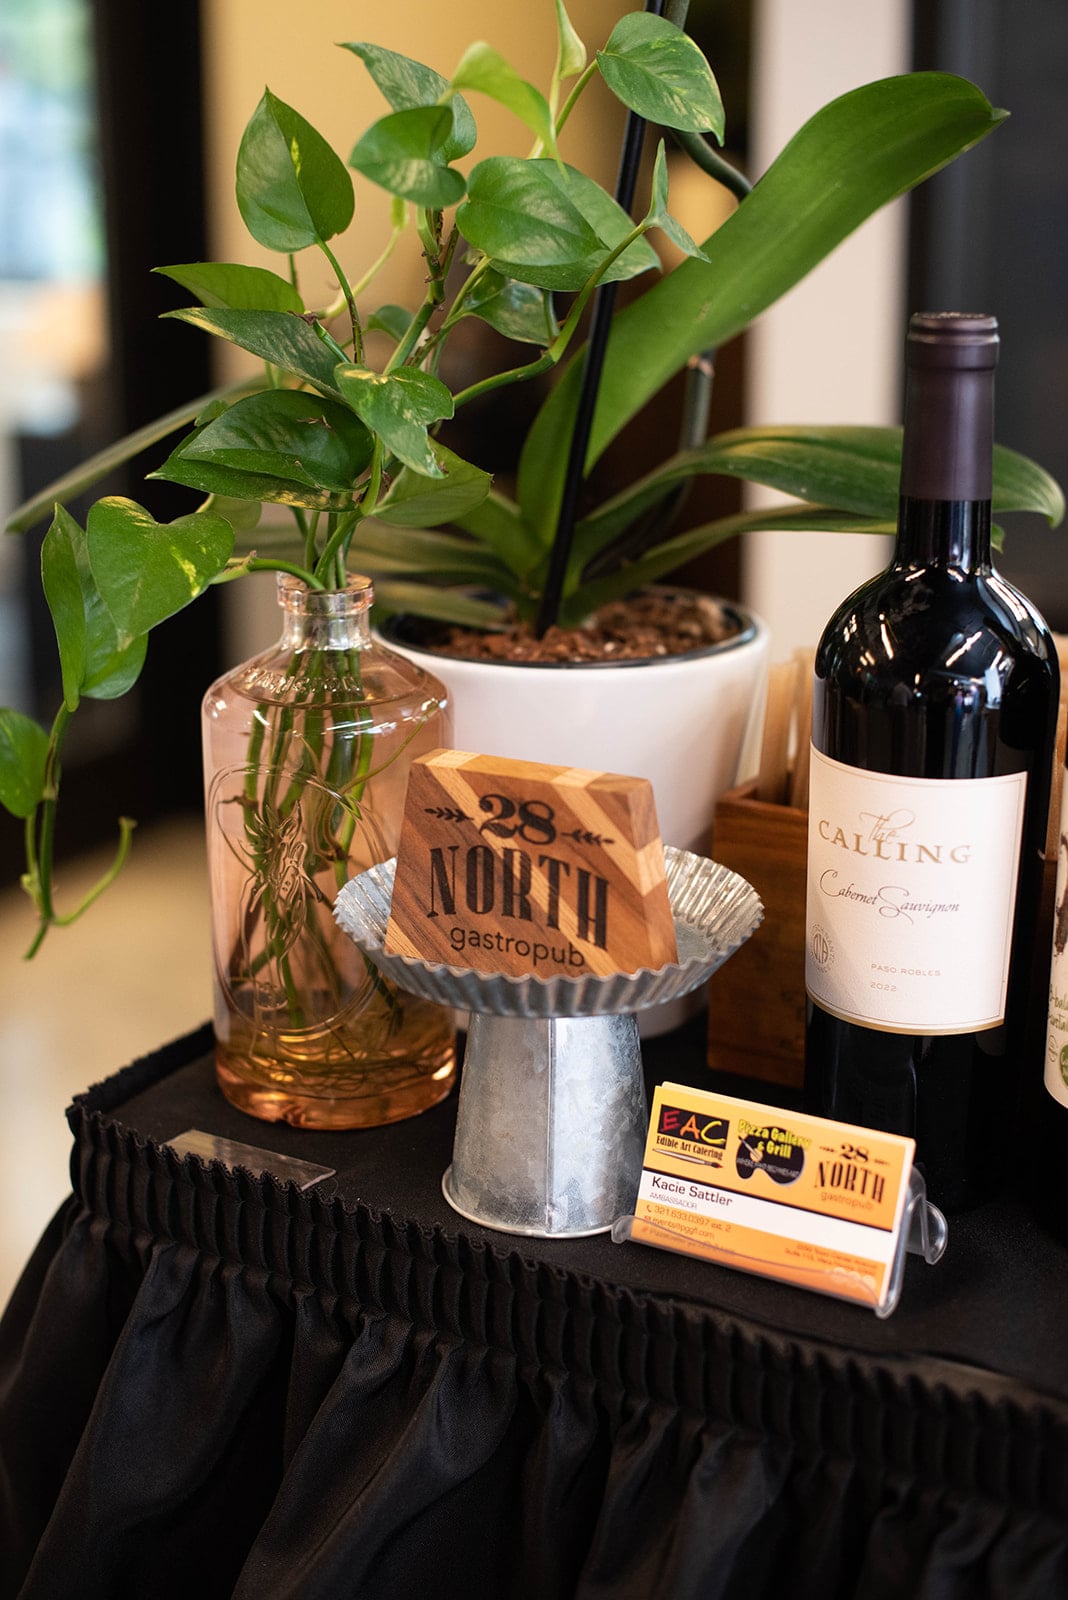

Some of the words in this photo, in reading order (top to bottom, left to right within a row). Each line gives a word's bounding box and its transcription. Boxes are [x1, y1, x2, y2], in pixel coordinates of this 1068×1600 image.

[479, 793, 557, 845] 28
[859, 809, 915, 844] The
[818, 820, 972, 864] CALLING
[427, 845, 609, 950] NORTH
[819, 868, 878, 906] Cabernet
[877, 886, 960, 925] Sauvignon
[450, 927, 585, 967] gastropub
[870, 981, 897, 992] 2022
[871, 963, 897, 974] PASO
[900, 968, 942, 977] ROBLES
[660, 1109, 726, 1145] EAC
[738, 1119, 769, 1139] Pizza
[771, 1127, 812, 1151] Gallery
[656, 1135, 679, 1149] Edible
[681, 1141, 692, 1152] Art
[693, 1145, 723, 1161] Catering
[766, 1140, 792, 1159] Grill
[840, 1142, 869, 1163] 28
[652, 1176, 686, 1195] Kacie
[689, 1185, 733, 1206] Sattler
[814, 1161, 885, 1204] NORTH
